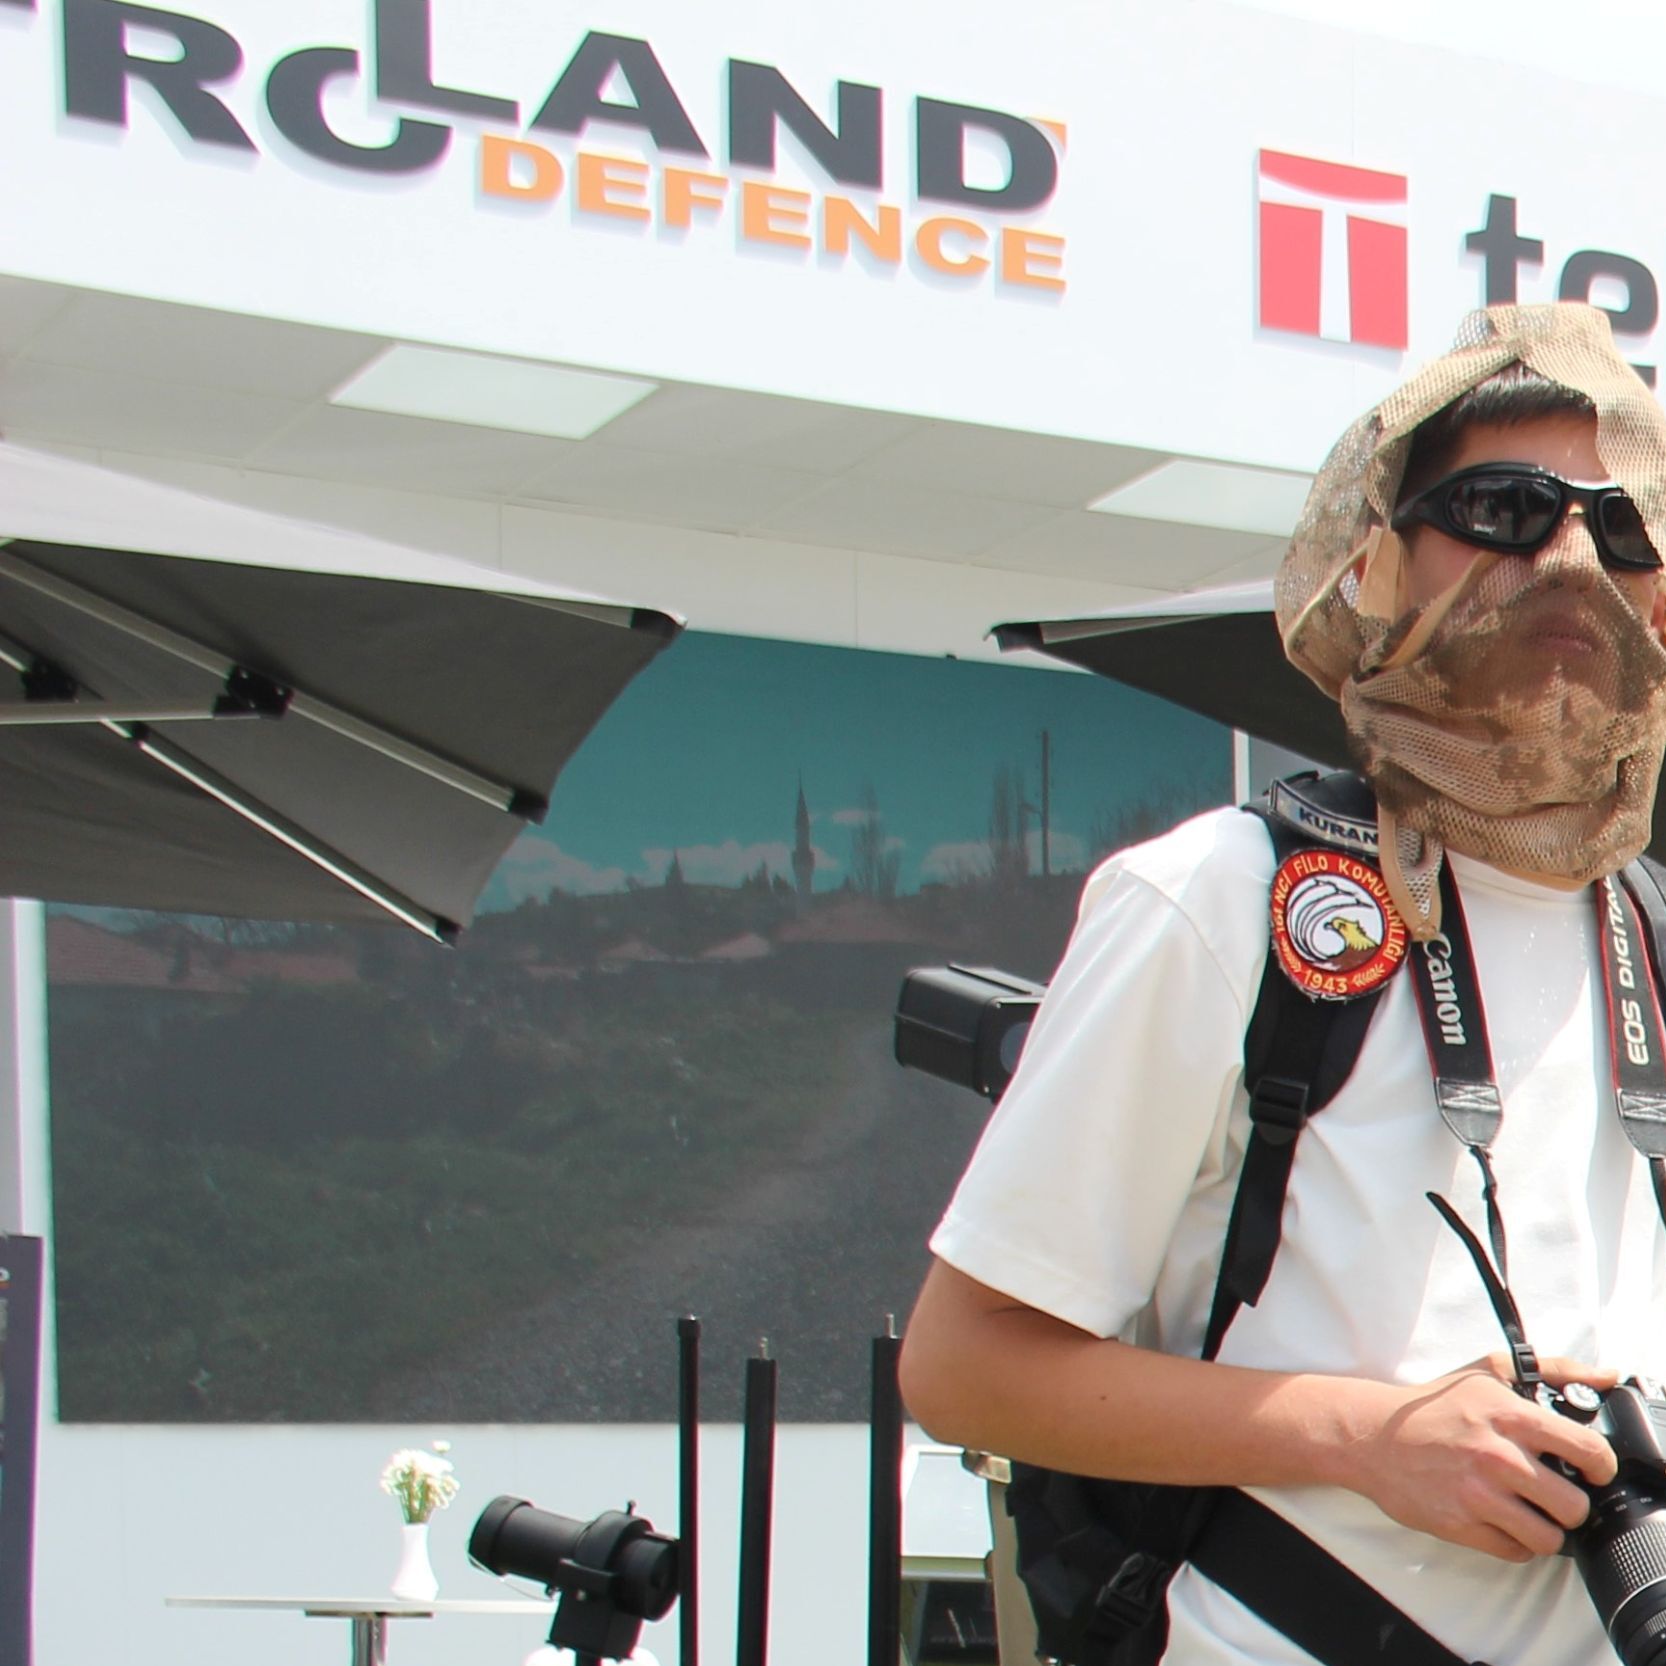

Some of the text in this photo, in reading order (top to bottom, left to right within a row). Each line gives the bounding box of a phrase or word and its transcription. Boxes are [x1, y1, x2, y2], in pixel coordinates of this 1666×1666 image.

[0, 0, 1060, 214] ROLAND
[481, 134, 1066, 292] DEFENCE
[1304, 970, 1348, 994] 1943
[1423, 932, 1466, 1045] Canon
[1622, 999, 1649, 1066] EOS
